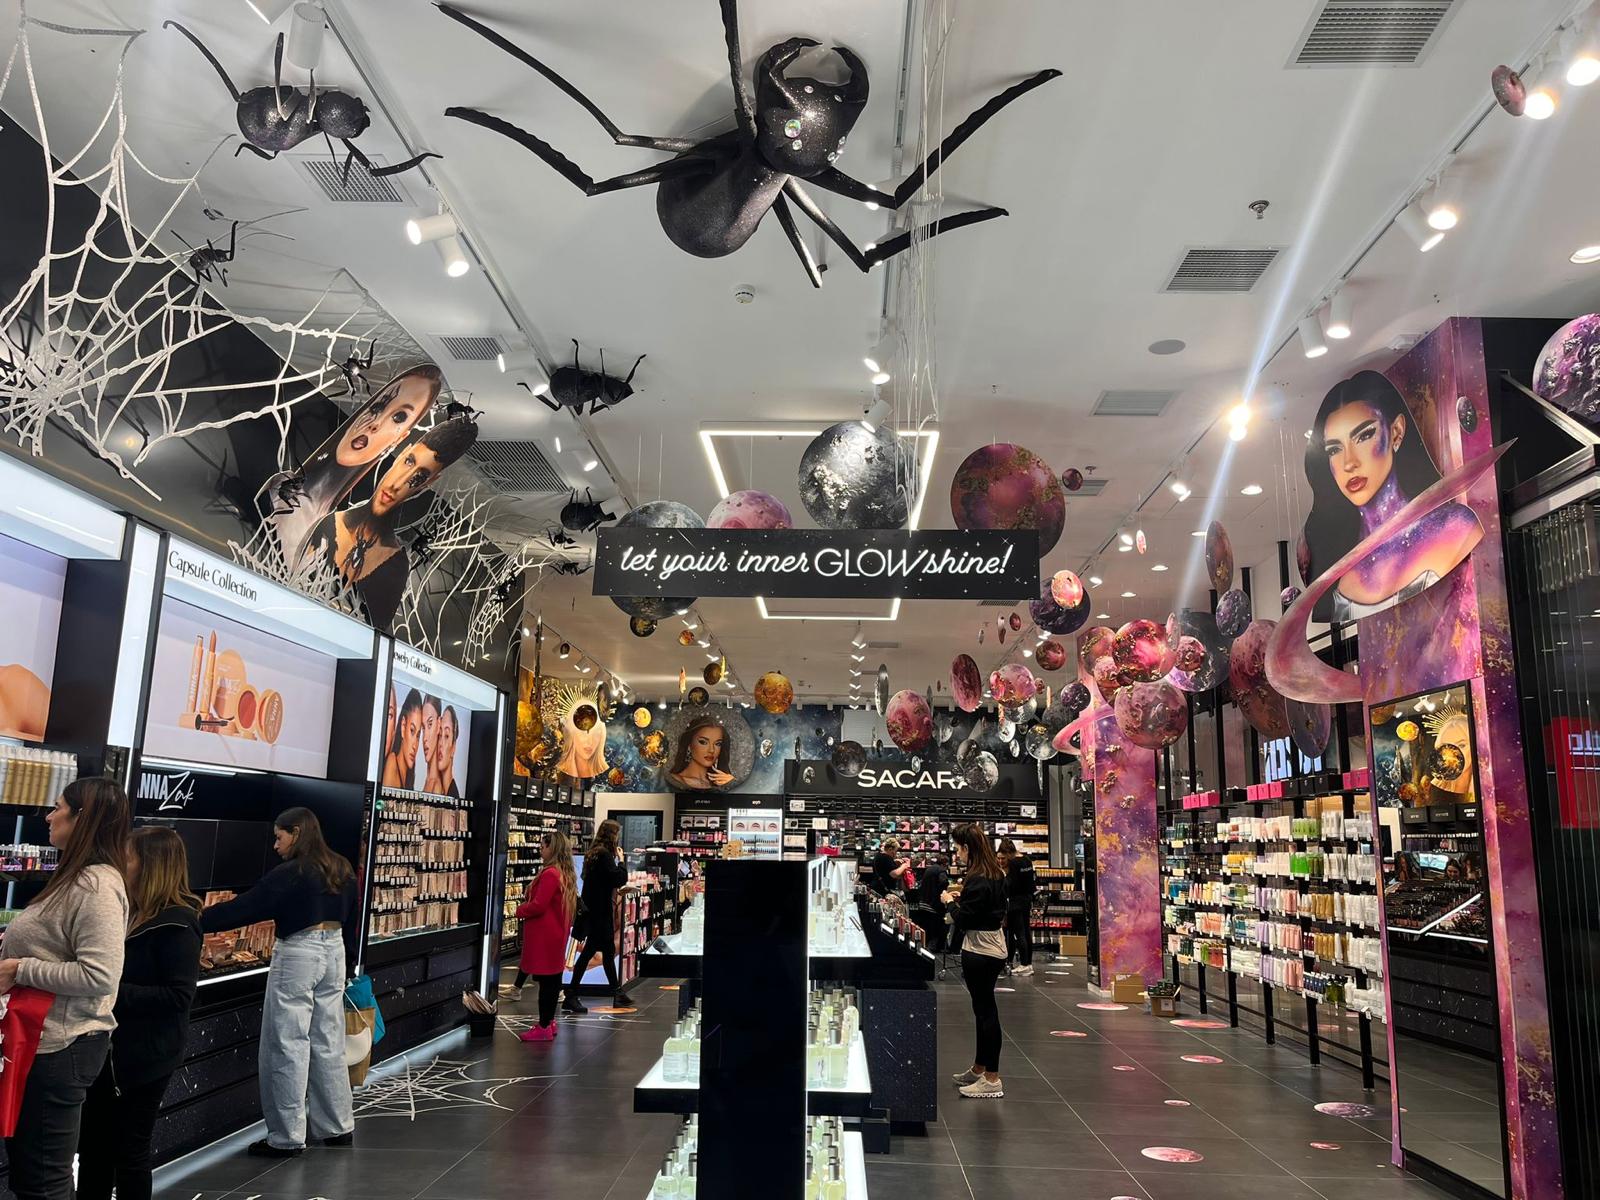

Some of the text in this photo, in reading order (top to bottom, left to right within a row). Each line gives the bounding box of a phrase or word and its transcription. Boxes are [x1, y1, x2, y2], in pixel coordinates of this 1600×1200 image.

[168, 550, 258, 602] Capsule Collection
[619, 544, 1013, 580] let your inner GLOW shine!
[393, 651, 409, 669] ewelry
[158, 770, 196, 811] Zak
